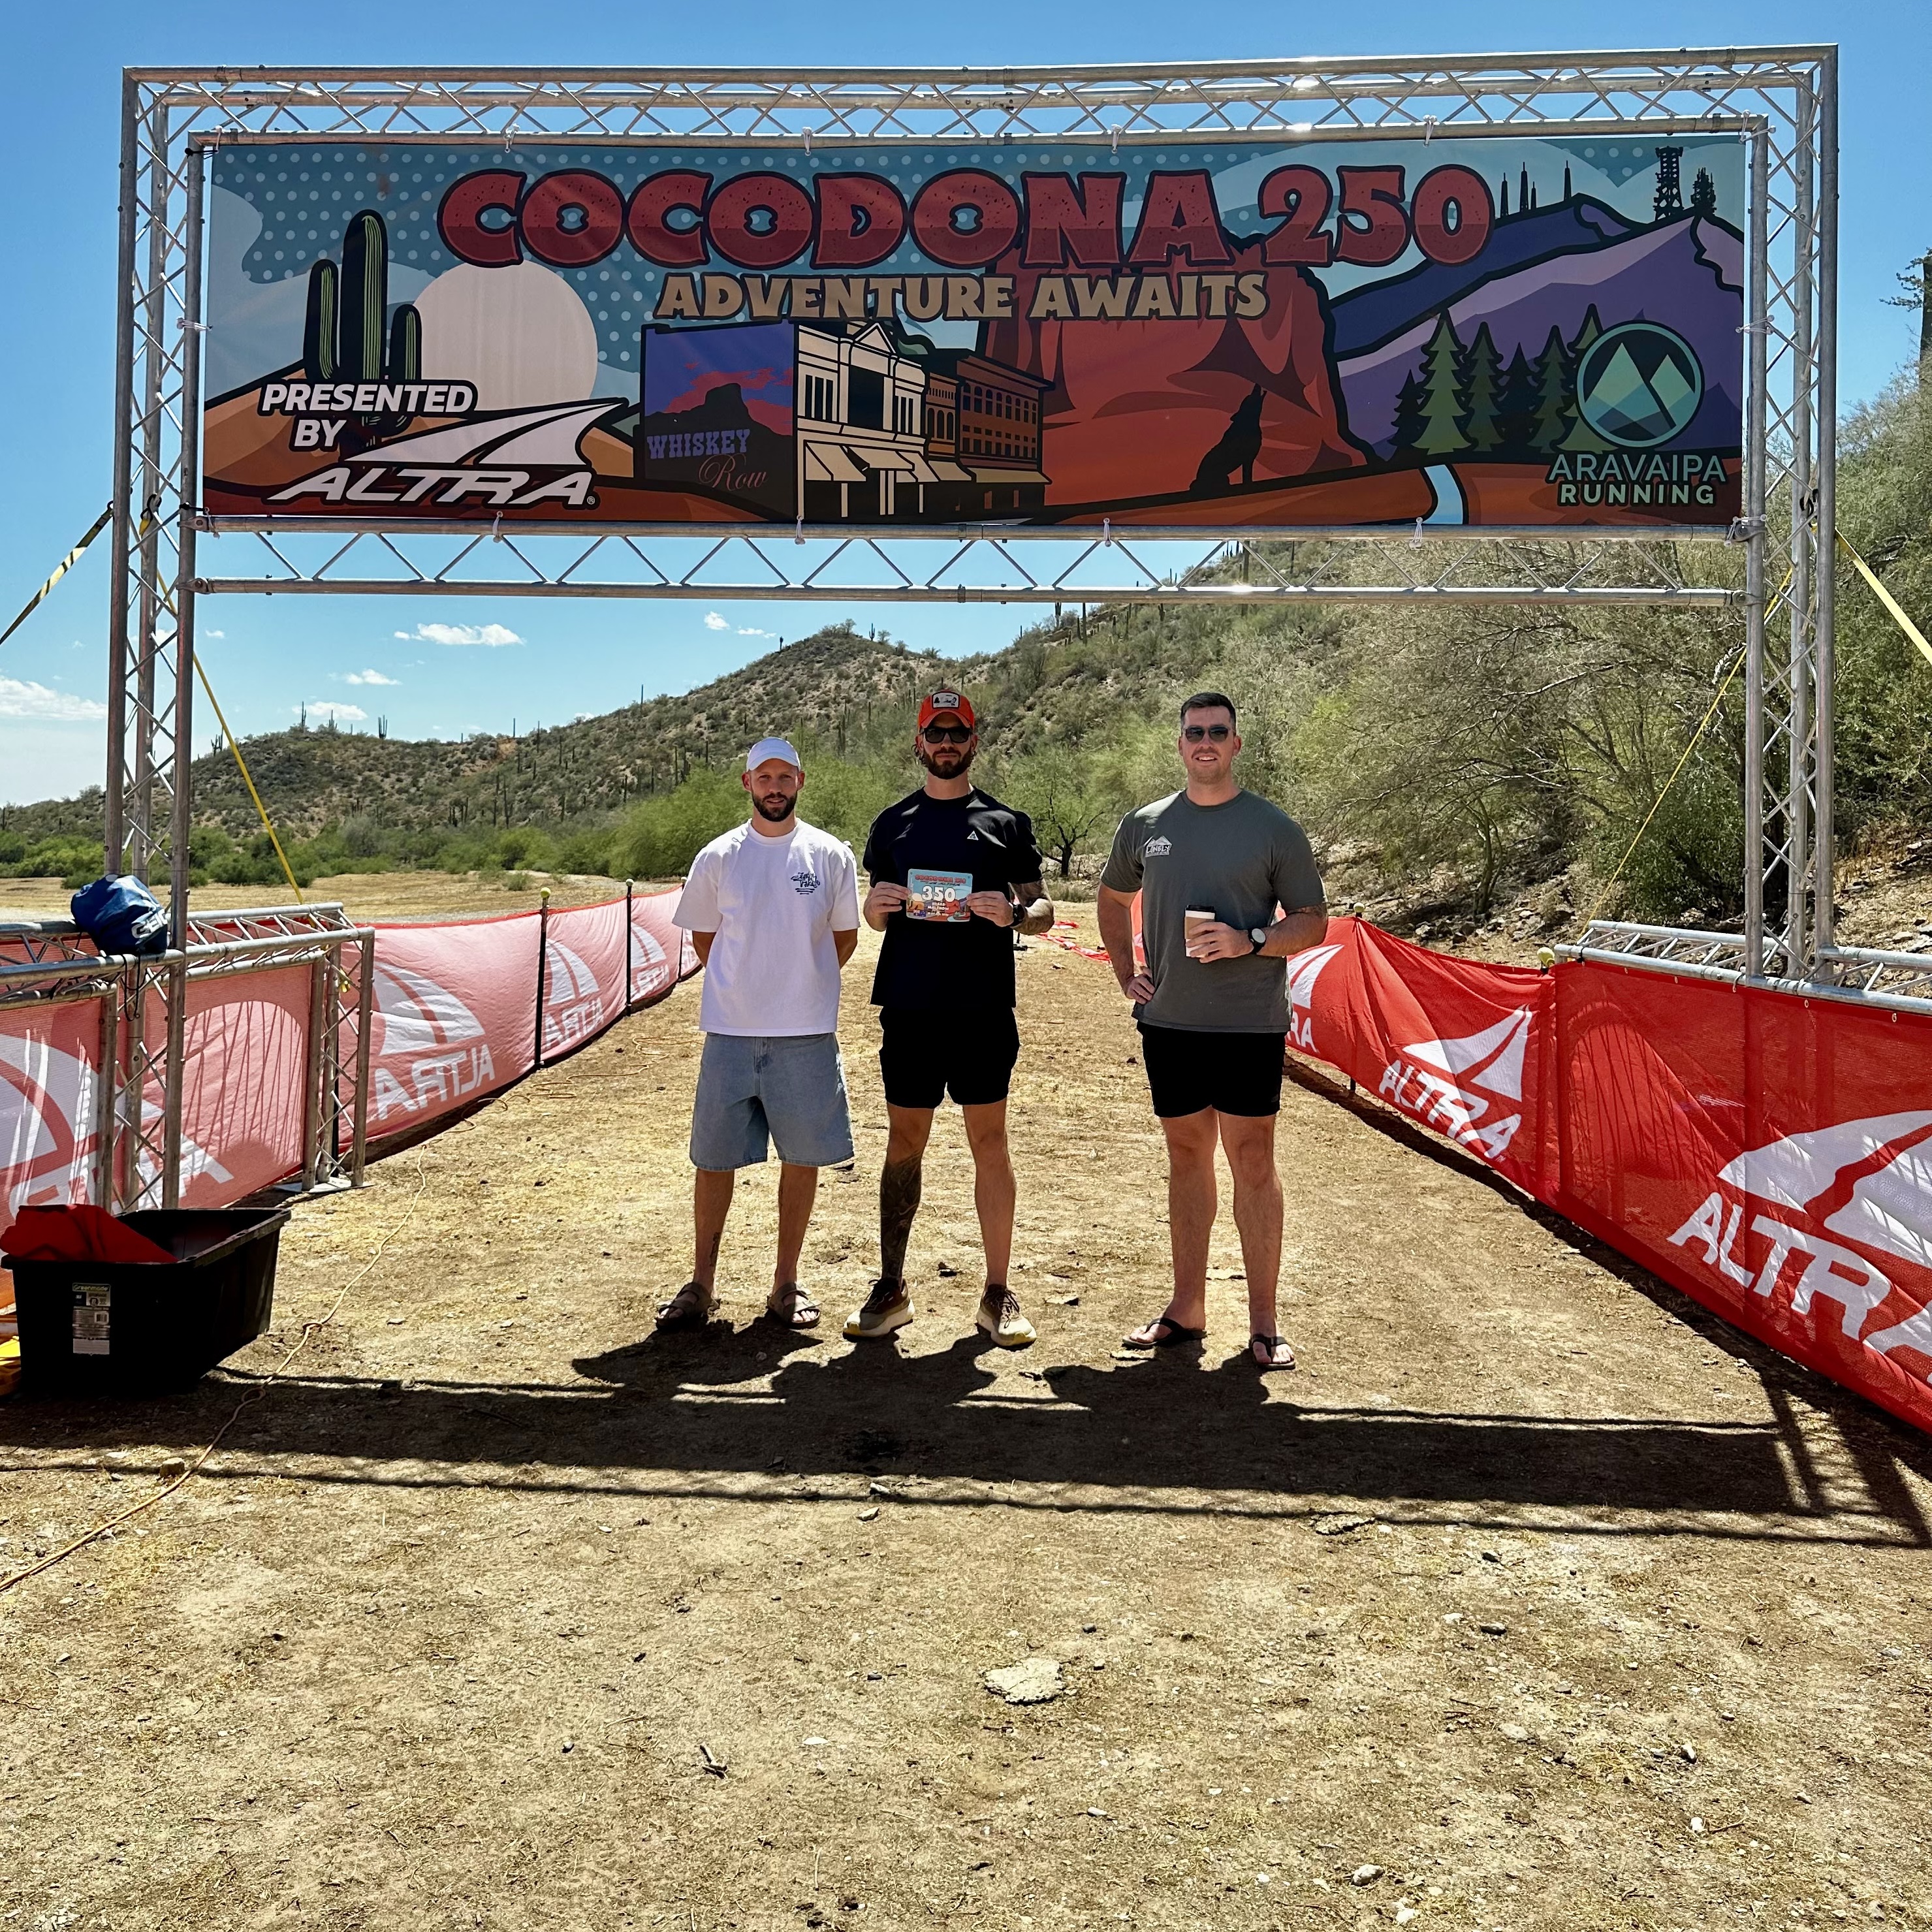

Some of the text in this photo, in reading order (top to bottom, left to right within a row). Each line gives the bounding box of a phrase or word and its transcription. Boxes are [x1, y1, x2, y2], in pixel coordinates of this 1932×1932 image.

[439, 165, 1494, 269] COCODONA 250
[657, 272, 1269, 321] ADVENTURE AWAITS
[262, 383, 474, 413] PRESENTED
[294, 419, 347, 447] BY
[646, 428, 750, 459] WHISKEY
[698, 452, 769, 492] Row
[1548, 454, 1726, 482] ARAVAIPA
[1560, 484, 1715, 504] RUNNING
[922, 885, 956, 902] 350
[131, 908, 168, 939] GEIC
[1378, 1059, 1522, 1158] ALTRA
